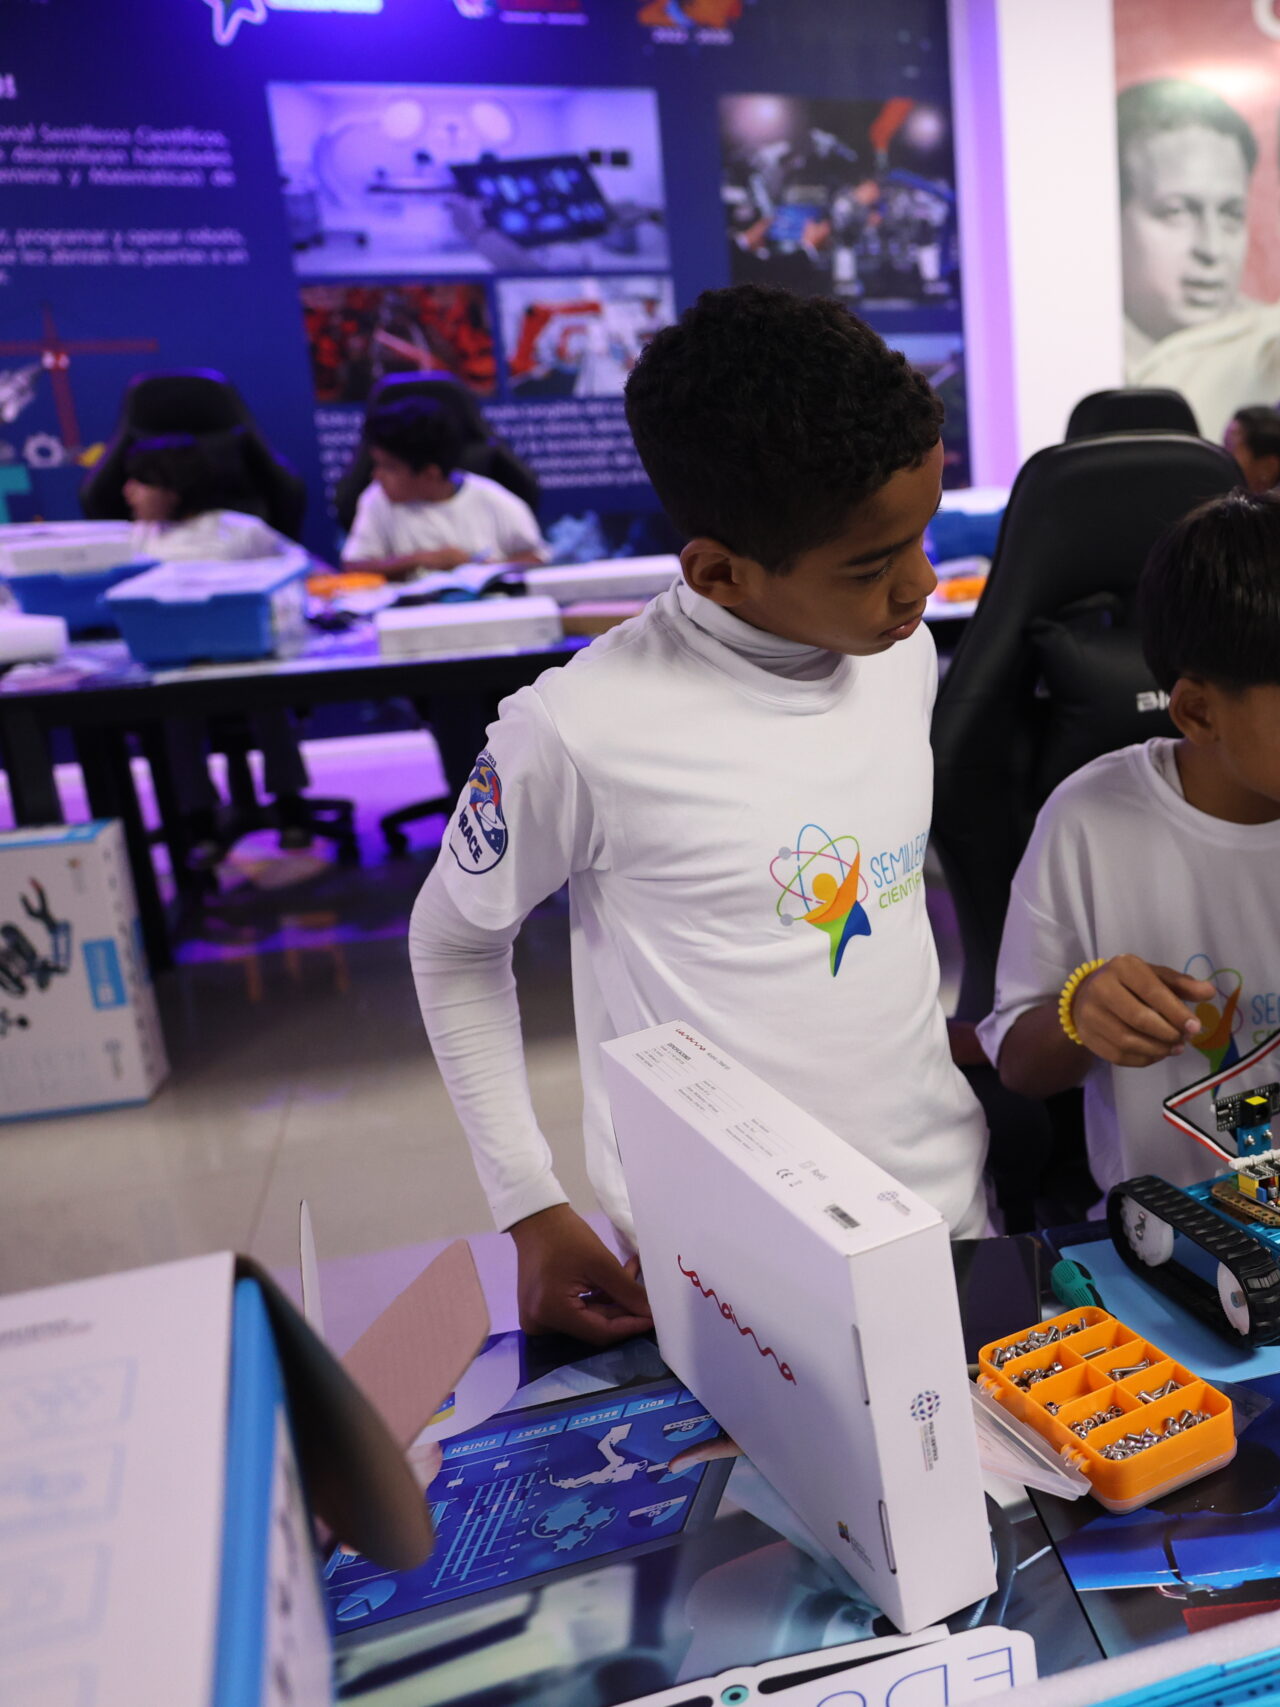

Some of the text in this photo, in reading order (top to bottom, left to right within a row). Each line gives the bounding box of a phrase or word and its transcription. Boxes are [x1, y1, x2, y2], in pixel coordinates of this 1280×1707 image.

[637, 1399, 665, 1411] EDIT
[570, 1409, 620, 1426] SELECT
[515, 1423, 557, 1439] START
[450, 1438, 497, 1454] FINISH
